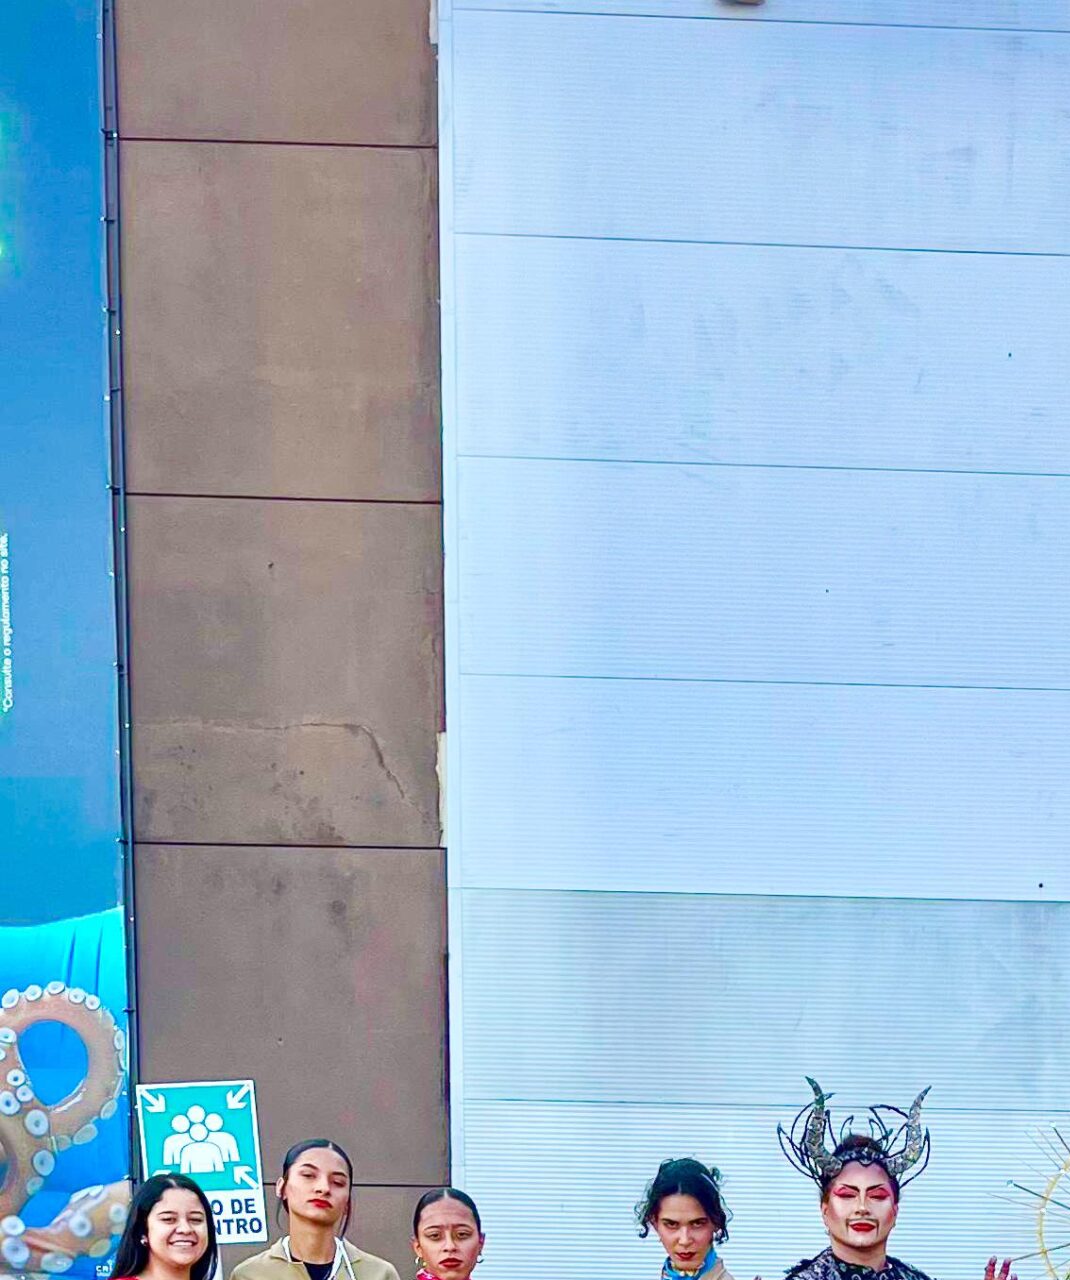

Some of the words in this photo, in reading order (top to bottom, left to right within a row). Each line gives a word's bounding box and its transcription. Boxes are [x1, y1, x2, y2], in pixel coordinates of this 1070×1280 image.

[1, 559, 9, 573] no
[210, 1199, 223, 1216] O
[231, 1198, 256, 1214] DE
